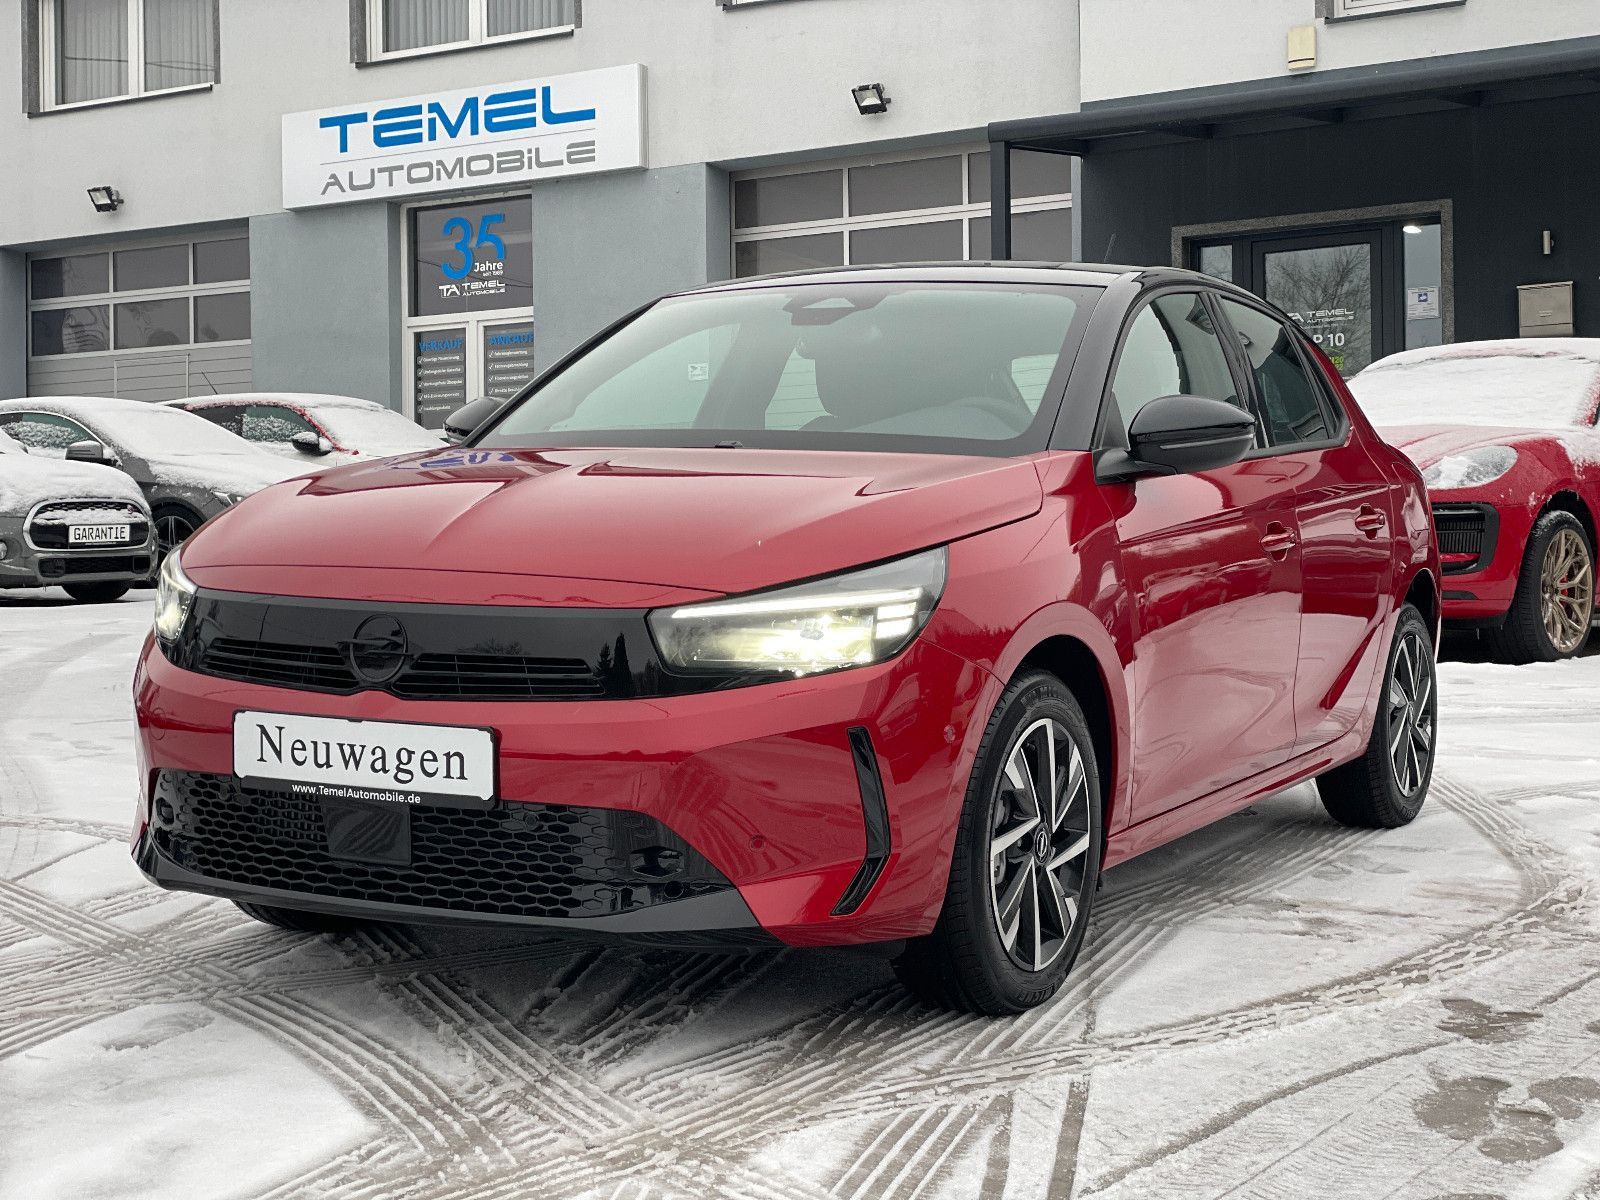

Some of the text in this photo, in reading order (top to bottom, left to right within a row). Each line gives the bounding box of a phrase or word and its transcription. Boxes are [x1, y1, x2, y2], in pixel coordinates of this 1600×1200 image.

[319, 85, 596, 153] TEMEL
[441, 213, 505, 280] 35
[473, 260, 504, 273] Jahre
[461, 280, 506, 290] TEMEL
[1306, 308, 1354, 318] TEMEL
[1327, 332, 1345, 347] 10
[74, 527, 126, 540] GARANTIE
[255, 724, 468, 785] Neuwagen
[291, 783, 421, 804] www.TemelAutomobile.de
